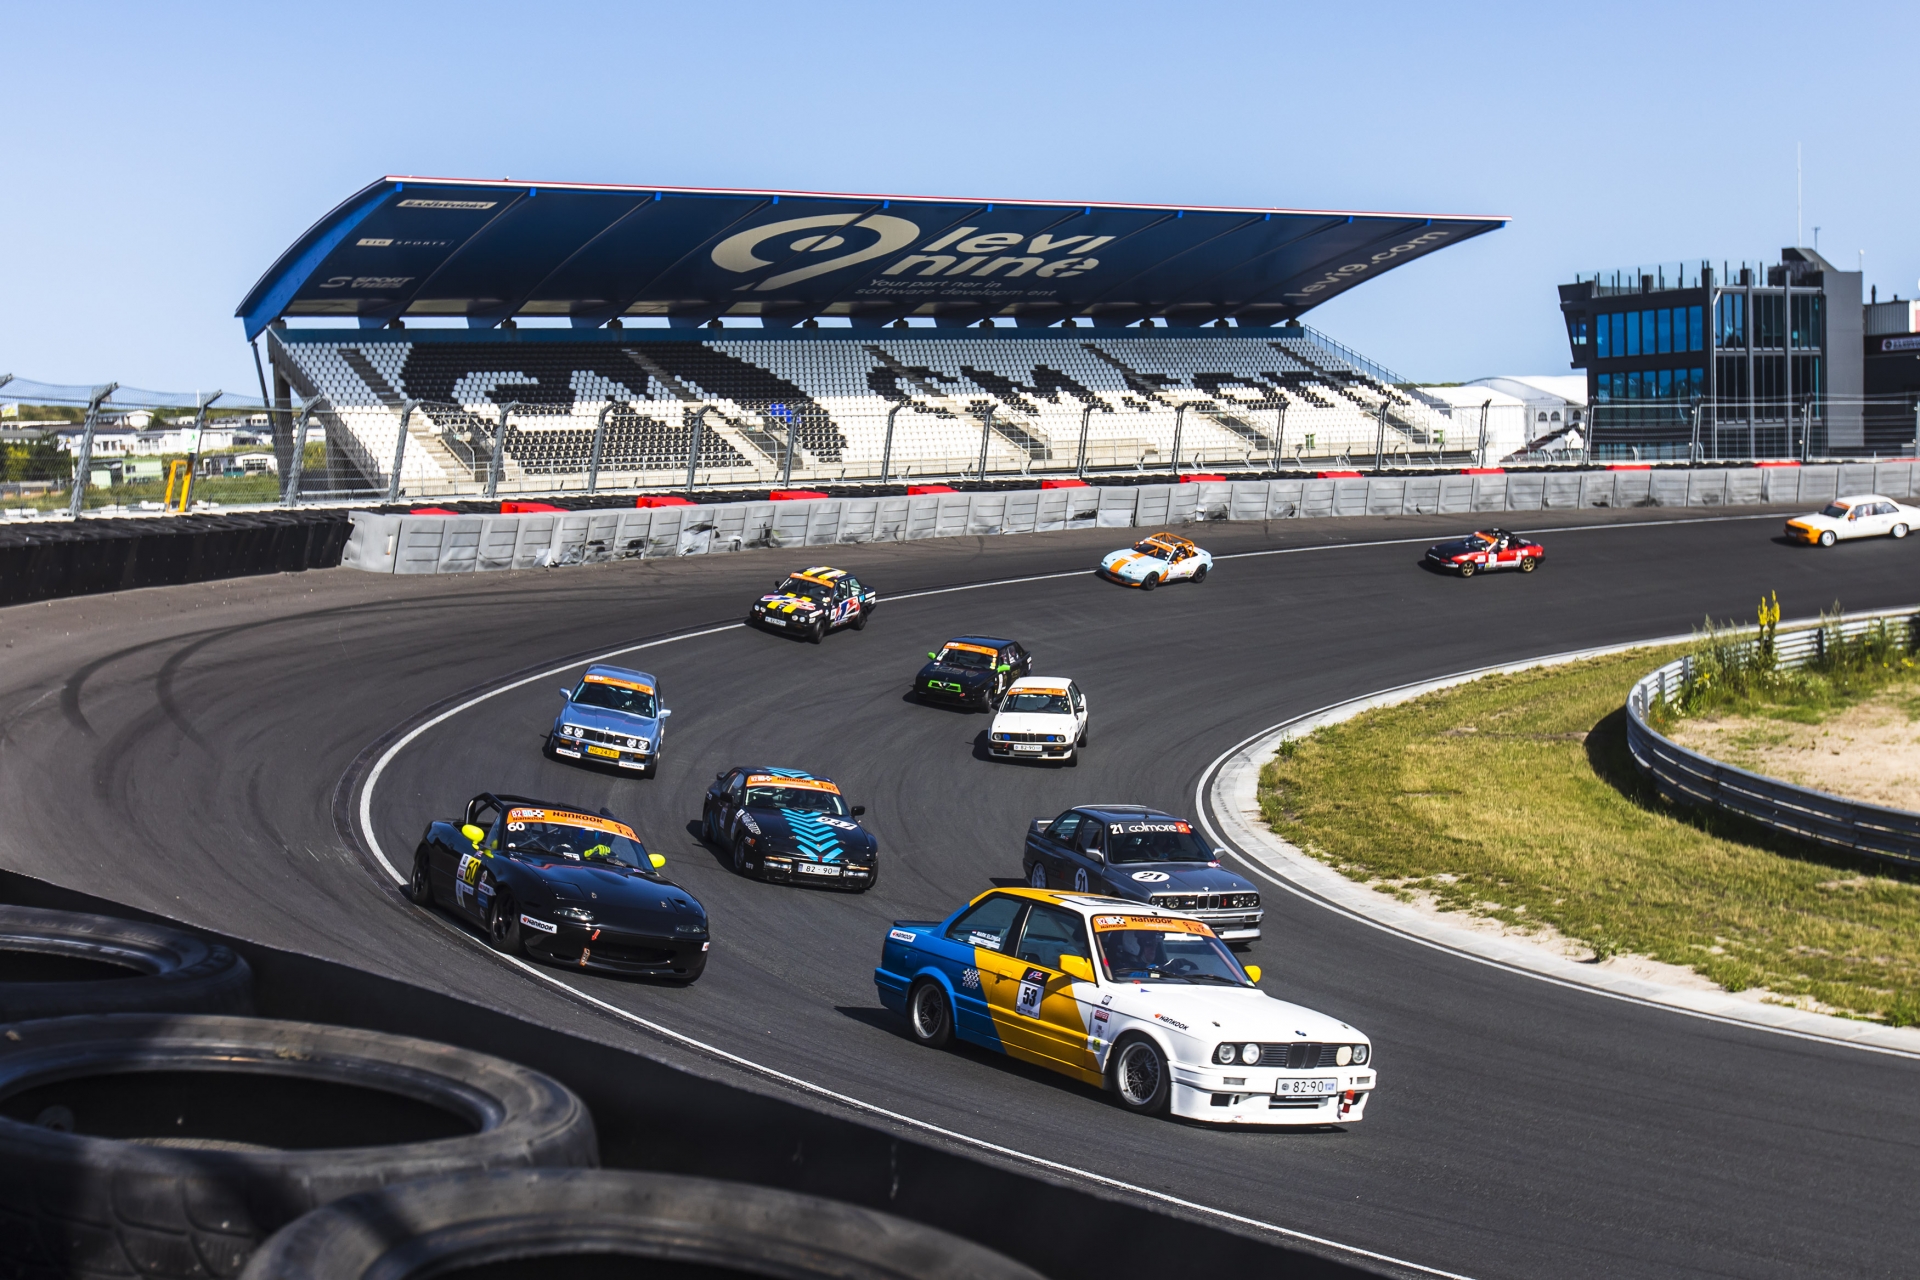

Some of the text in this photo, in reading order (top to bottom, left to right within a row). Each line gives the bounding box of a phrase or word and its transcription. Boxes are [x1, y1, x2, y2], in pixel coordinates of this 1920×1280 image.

[920, 226, 1117, 254] levi
[881, 254, 1100, 278] nine
[869, 279, 904, 288] Your
[855, 287, 935, 296] software
[507, 822, 525, 831] 60
[1109, 823, 1124, 835] 21
[1128, 821, 1177, 833] colmore
[464, 859, 479, 883] 60
[1138, 872, 1163, 881] 21
[1022, 986, 1038, 1007] 53
[1292, 1080, 1324, 1093] 82-90
